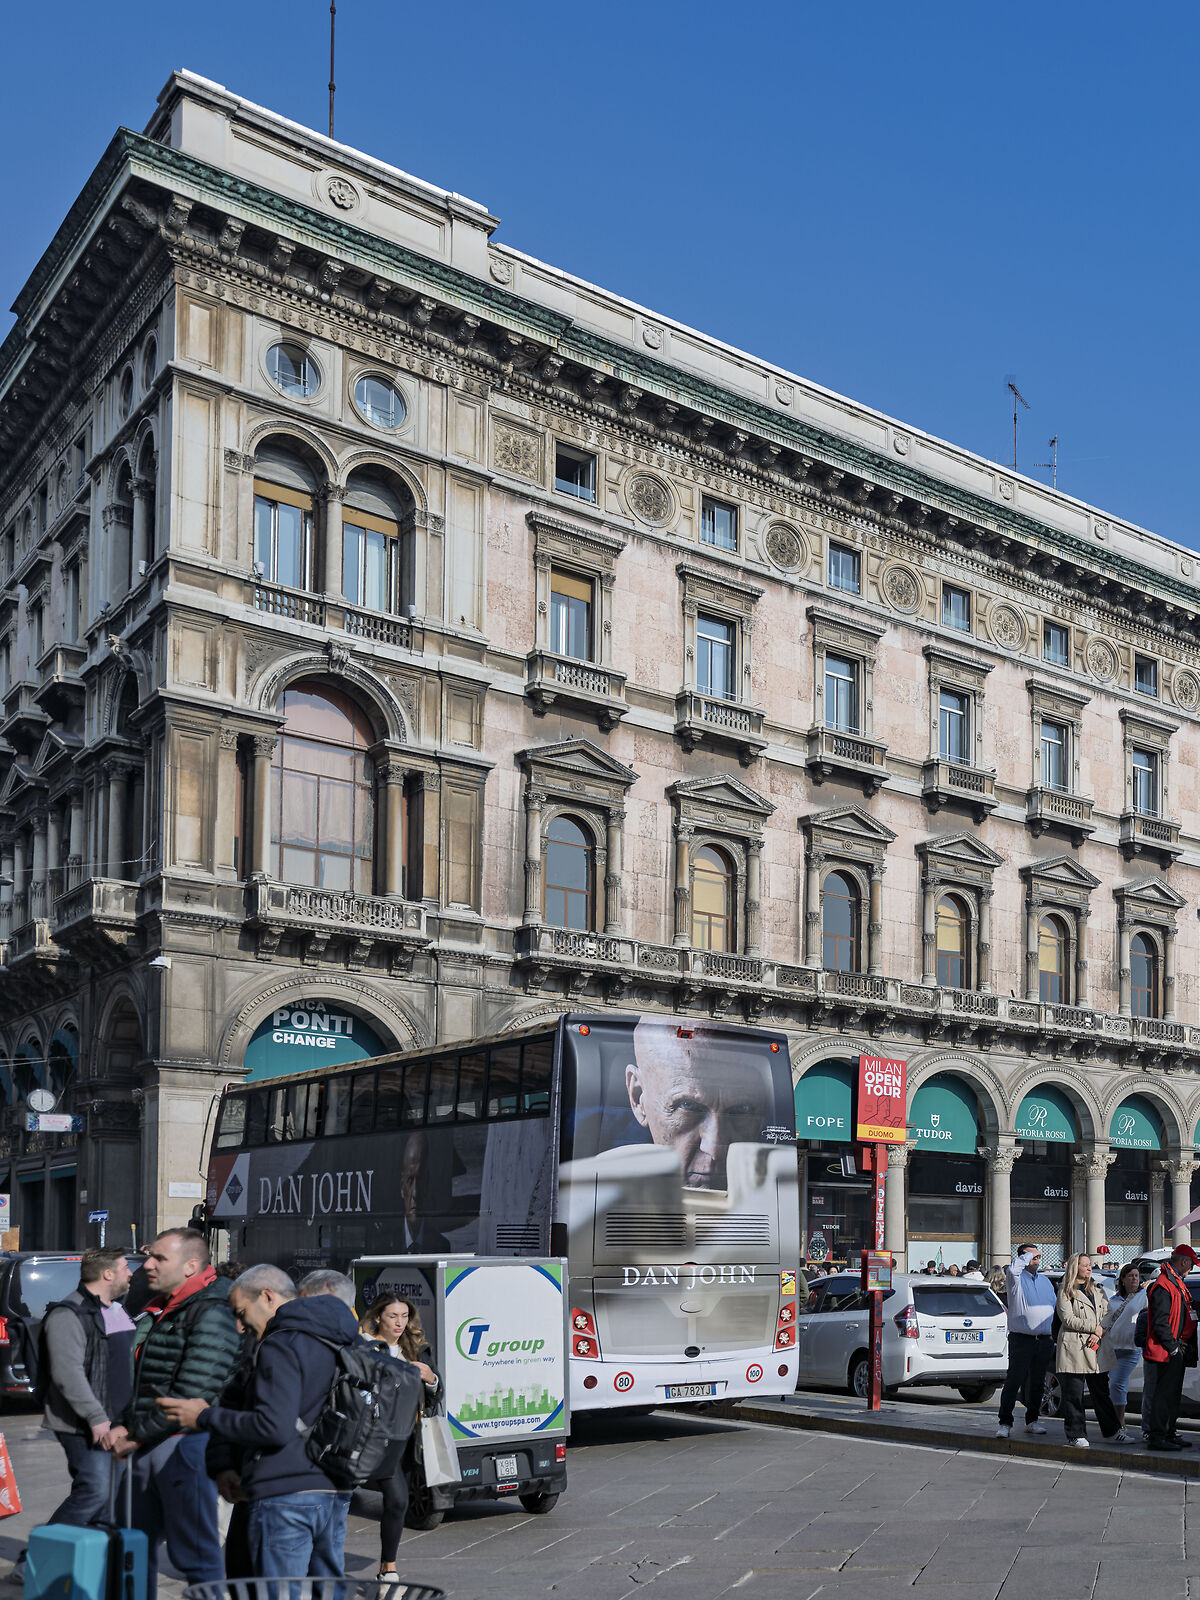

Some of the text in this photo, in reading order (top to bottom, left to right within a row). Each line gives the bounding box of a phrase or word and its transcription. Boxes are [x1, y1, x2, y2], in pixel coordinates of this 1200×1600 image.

[284, 1000, 326, 1012] ANCA
[273, 1009, 353, 1034] PONTI
[272, 1032, 336, 1049] CHANGE
[864, 1058, 902, 1075] MILAN
[864, 1072, 902, 1087] OPEN
[864, 1083, 901, 1099] TOUR
[807, 1116, 845, 1128] FOPE
[868, 1130, 894, 1139] DUOMO
[916, 1128, 952, 1140] TUDOR
[1014, 1128, 1066, 1140] RTORIA ROSSI
[1133, 1138, 1152, 1147] ROSSI
[955, 1182, 983, 1193] davis
[1044, 1186, 1069, 1197] davis
[258, 1174, 304, 1215] DAN
[307, 1170, 374, 1227] JOHN
[1125, 1190, 1148, 1201] davis
[621, 1266, 680, 1286] DAN
[686, 1265, 758, 1290] JOHN
[394, 1283, 423, 1297] ELECTRIC
[468, 1324, 545, 1357] T group
[482, 1359, 514, 1368] Anywhere
[523, 1357, 541, 1365] green
[749, 1369, 760, 1378] 100
[618, 1376, 630, 1388] 80
[671, 1385, 711, 1398] GA 782YJ
[471, 1416, 541, 1430] www.tgroupspa.com
[462, 1468, 480, 1477] VEM
